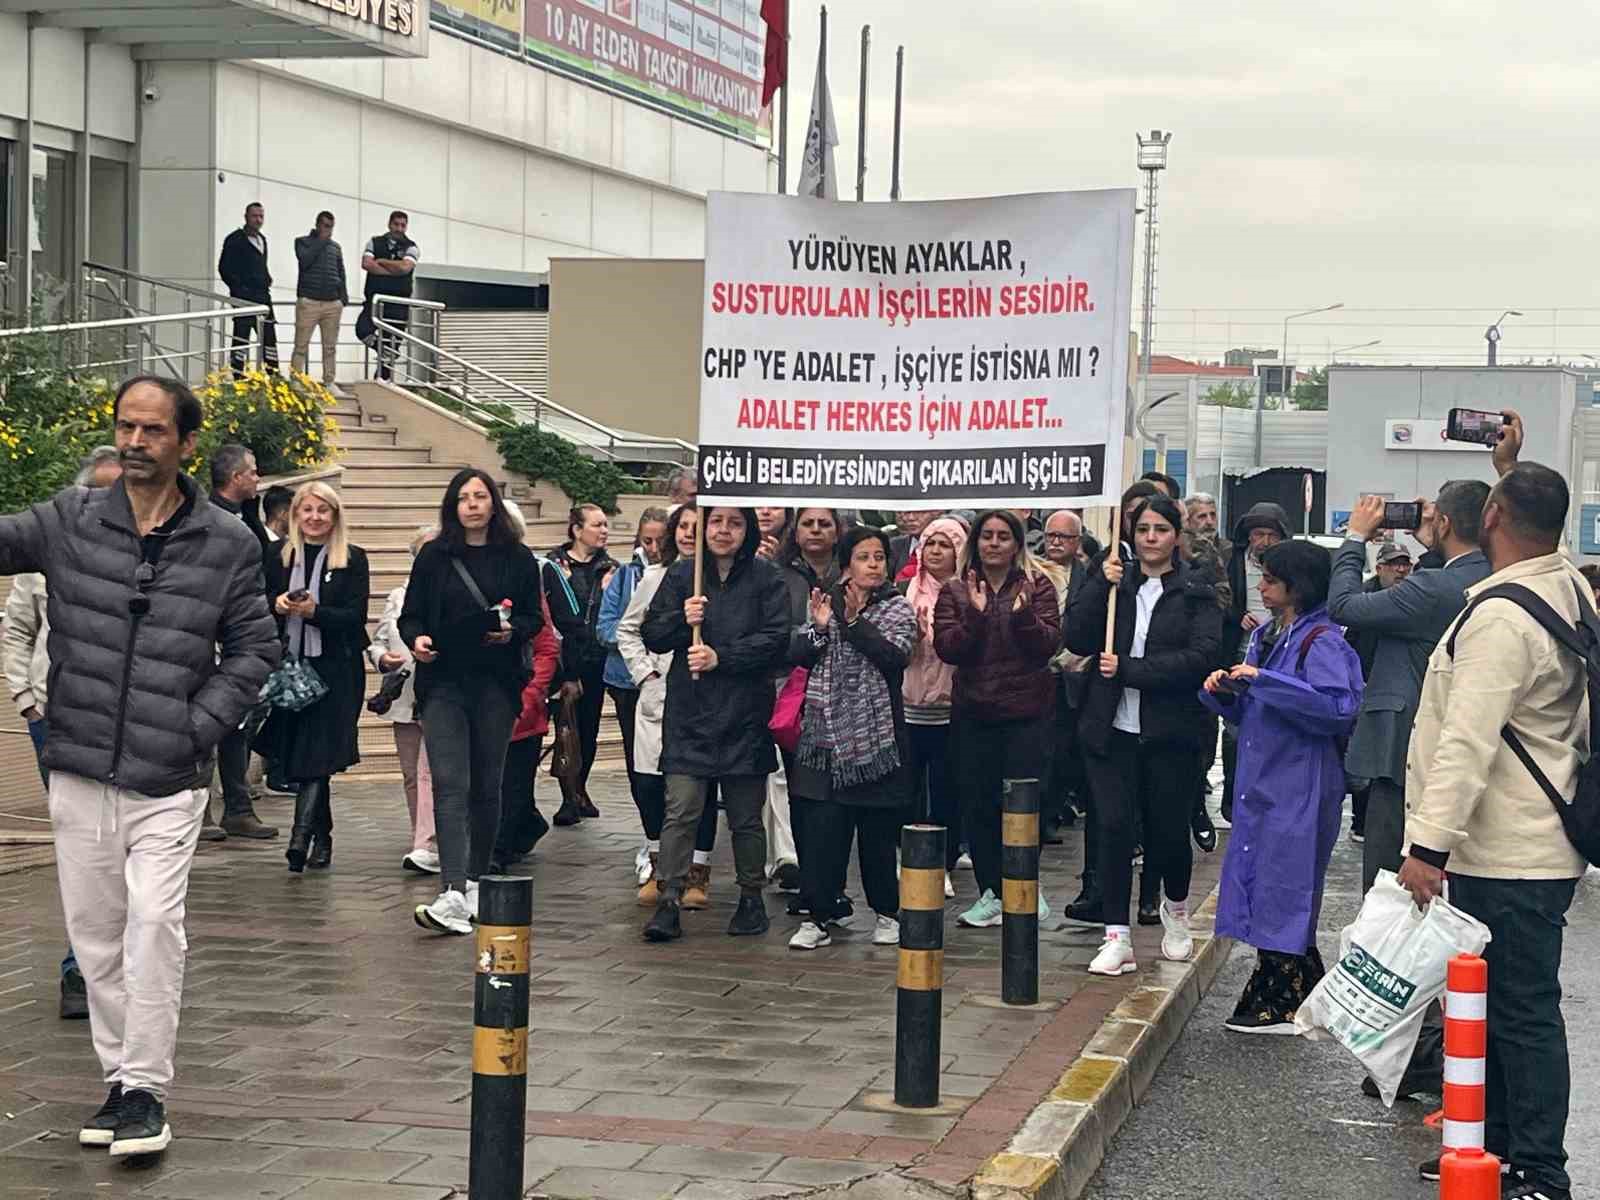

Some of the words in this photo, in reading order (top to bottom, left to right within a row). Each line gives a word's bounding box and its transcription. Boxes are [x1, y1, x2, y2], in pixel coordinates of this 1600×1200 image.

[545, 3, 564, 41] 10
[567, 14, 589, 50] AY
[593, 23, 639, 72] ELDEN
[643, 44, 689, 91] TAKSİT
[788, 233, 897, 275] YÜRÜYEN
[905, 239, 1012, 274] AYAKLAR
[712, 282, 870, 318] SUSTURULAN
[878, 279, 992, 327] İŞÇİLERİN
[999, 275, 1095, 316] SESİDİR.
[704, 347, 747, 379] CHP
[754, 349, 786, 380] 'YE
[792, 351, 876, 383] ADALET
[894, 345, 963, 391] İŞÇİYE
[970, 343, 1051, 382] İSTİSNA
[1057, 347, 1081, 378] MI
[737, 398, 821, 431] ADALET
[826, 400, 912, 432] HERKES
[918, 394, 962, 440] İÇİN
[968, 397, 1063, 431] ADALET...
[703, 450, 752, 489] ÇİĞLİ
[757, 453, 914, 487] BELEDİYESİNDEN
[919, 457, 1017, 493] ÇIKARILAN
[1021, 451, 1092, 490] İŞÇİLER
